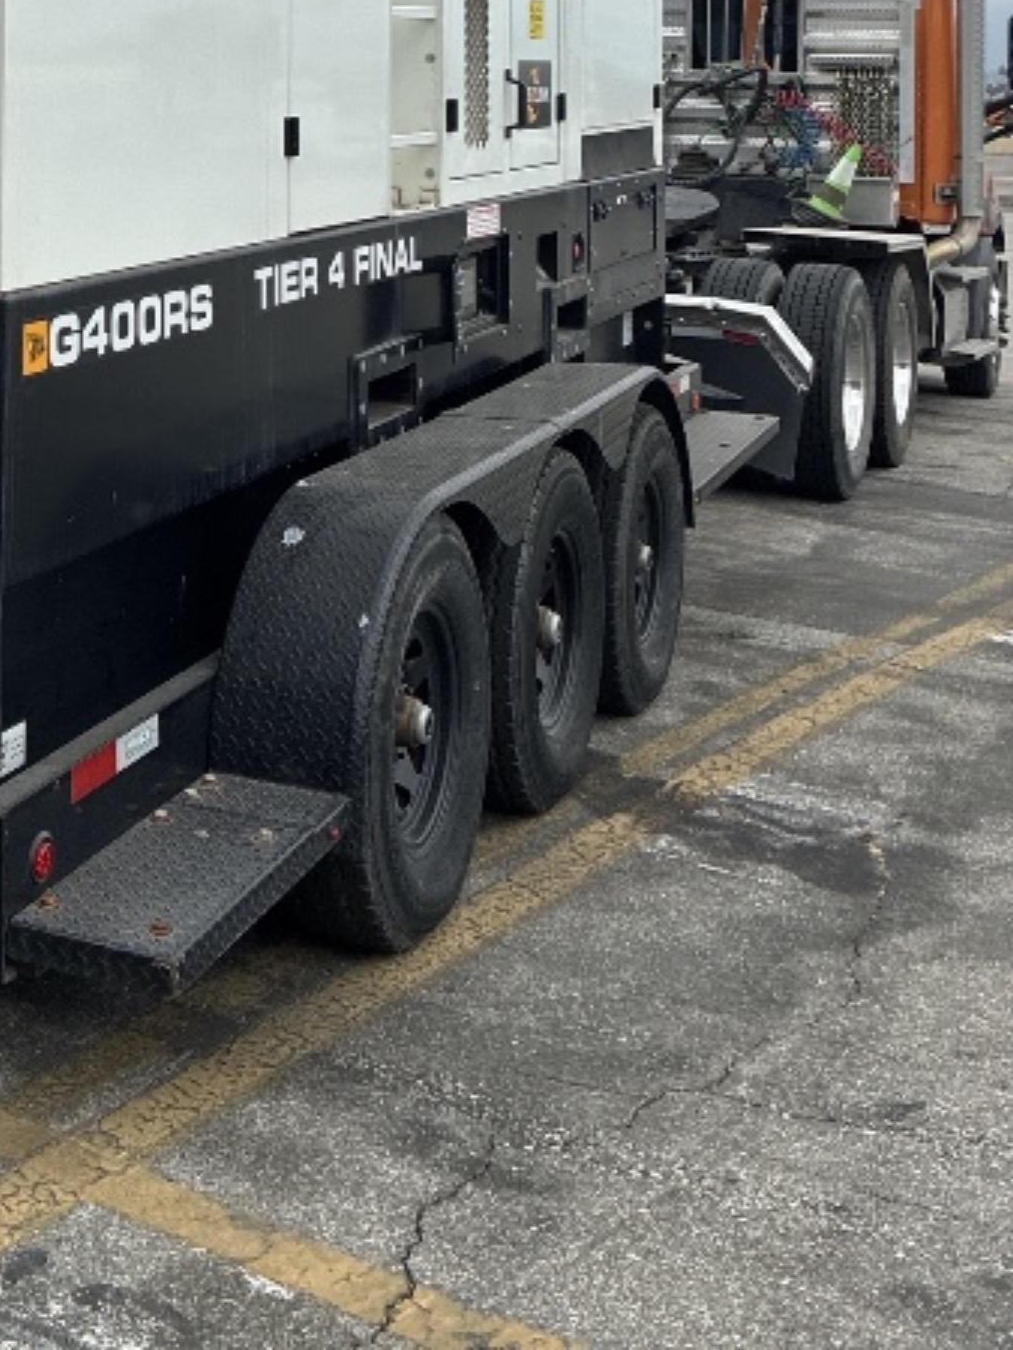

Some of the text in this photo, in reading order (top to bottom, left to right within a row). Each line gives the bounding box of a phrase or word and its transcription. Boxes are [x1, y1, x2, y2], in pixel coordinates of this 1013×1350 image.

[253, 236, 424, 310] TIER 4 FINAL
[49, 284, 214, 368] G400RS
